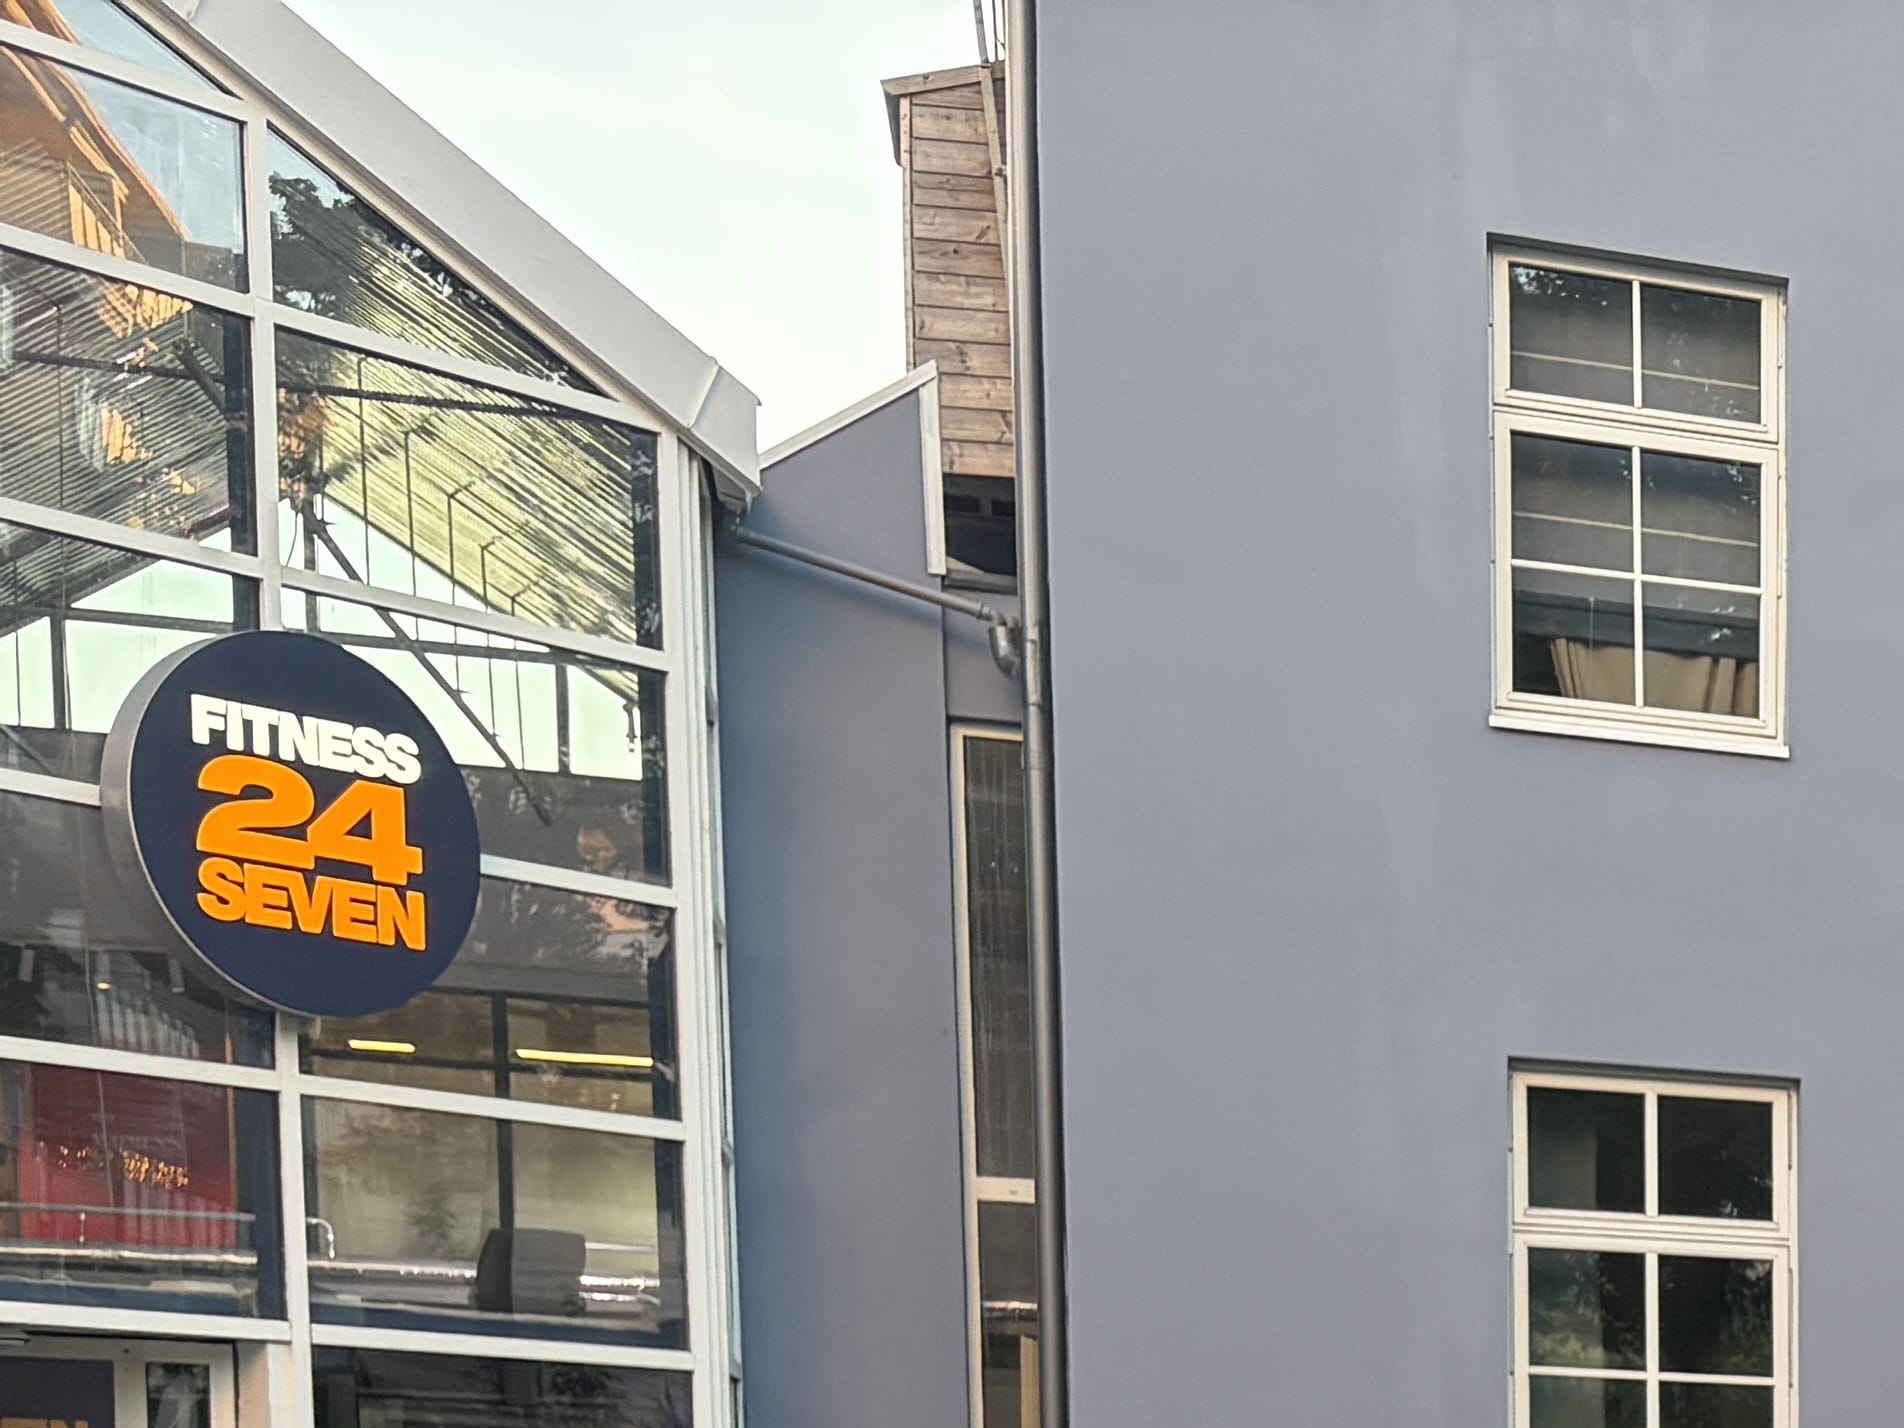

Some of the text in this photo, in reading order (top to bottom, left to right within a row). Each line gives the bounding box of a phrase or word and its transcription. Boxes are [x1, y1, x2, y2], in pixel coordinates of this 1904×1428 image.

[190, 693, 422, 785] FITNESS
[196, 753, 424, 886] 24
[196, 855, 427, 951] SEVEN
